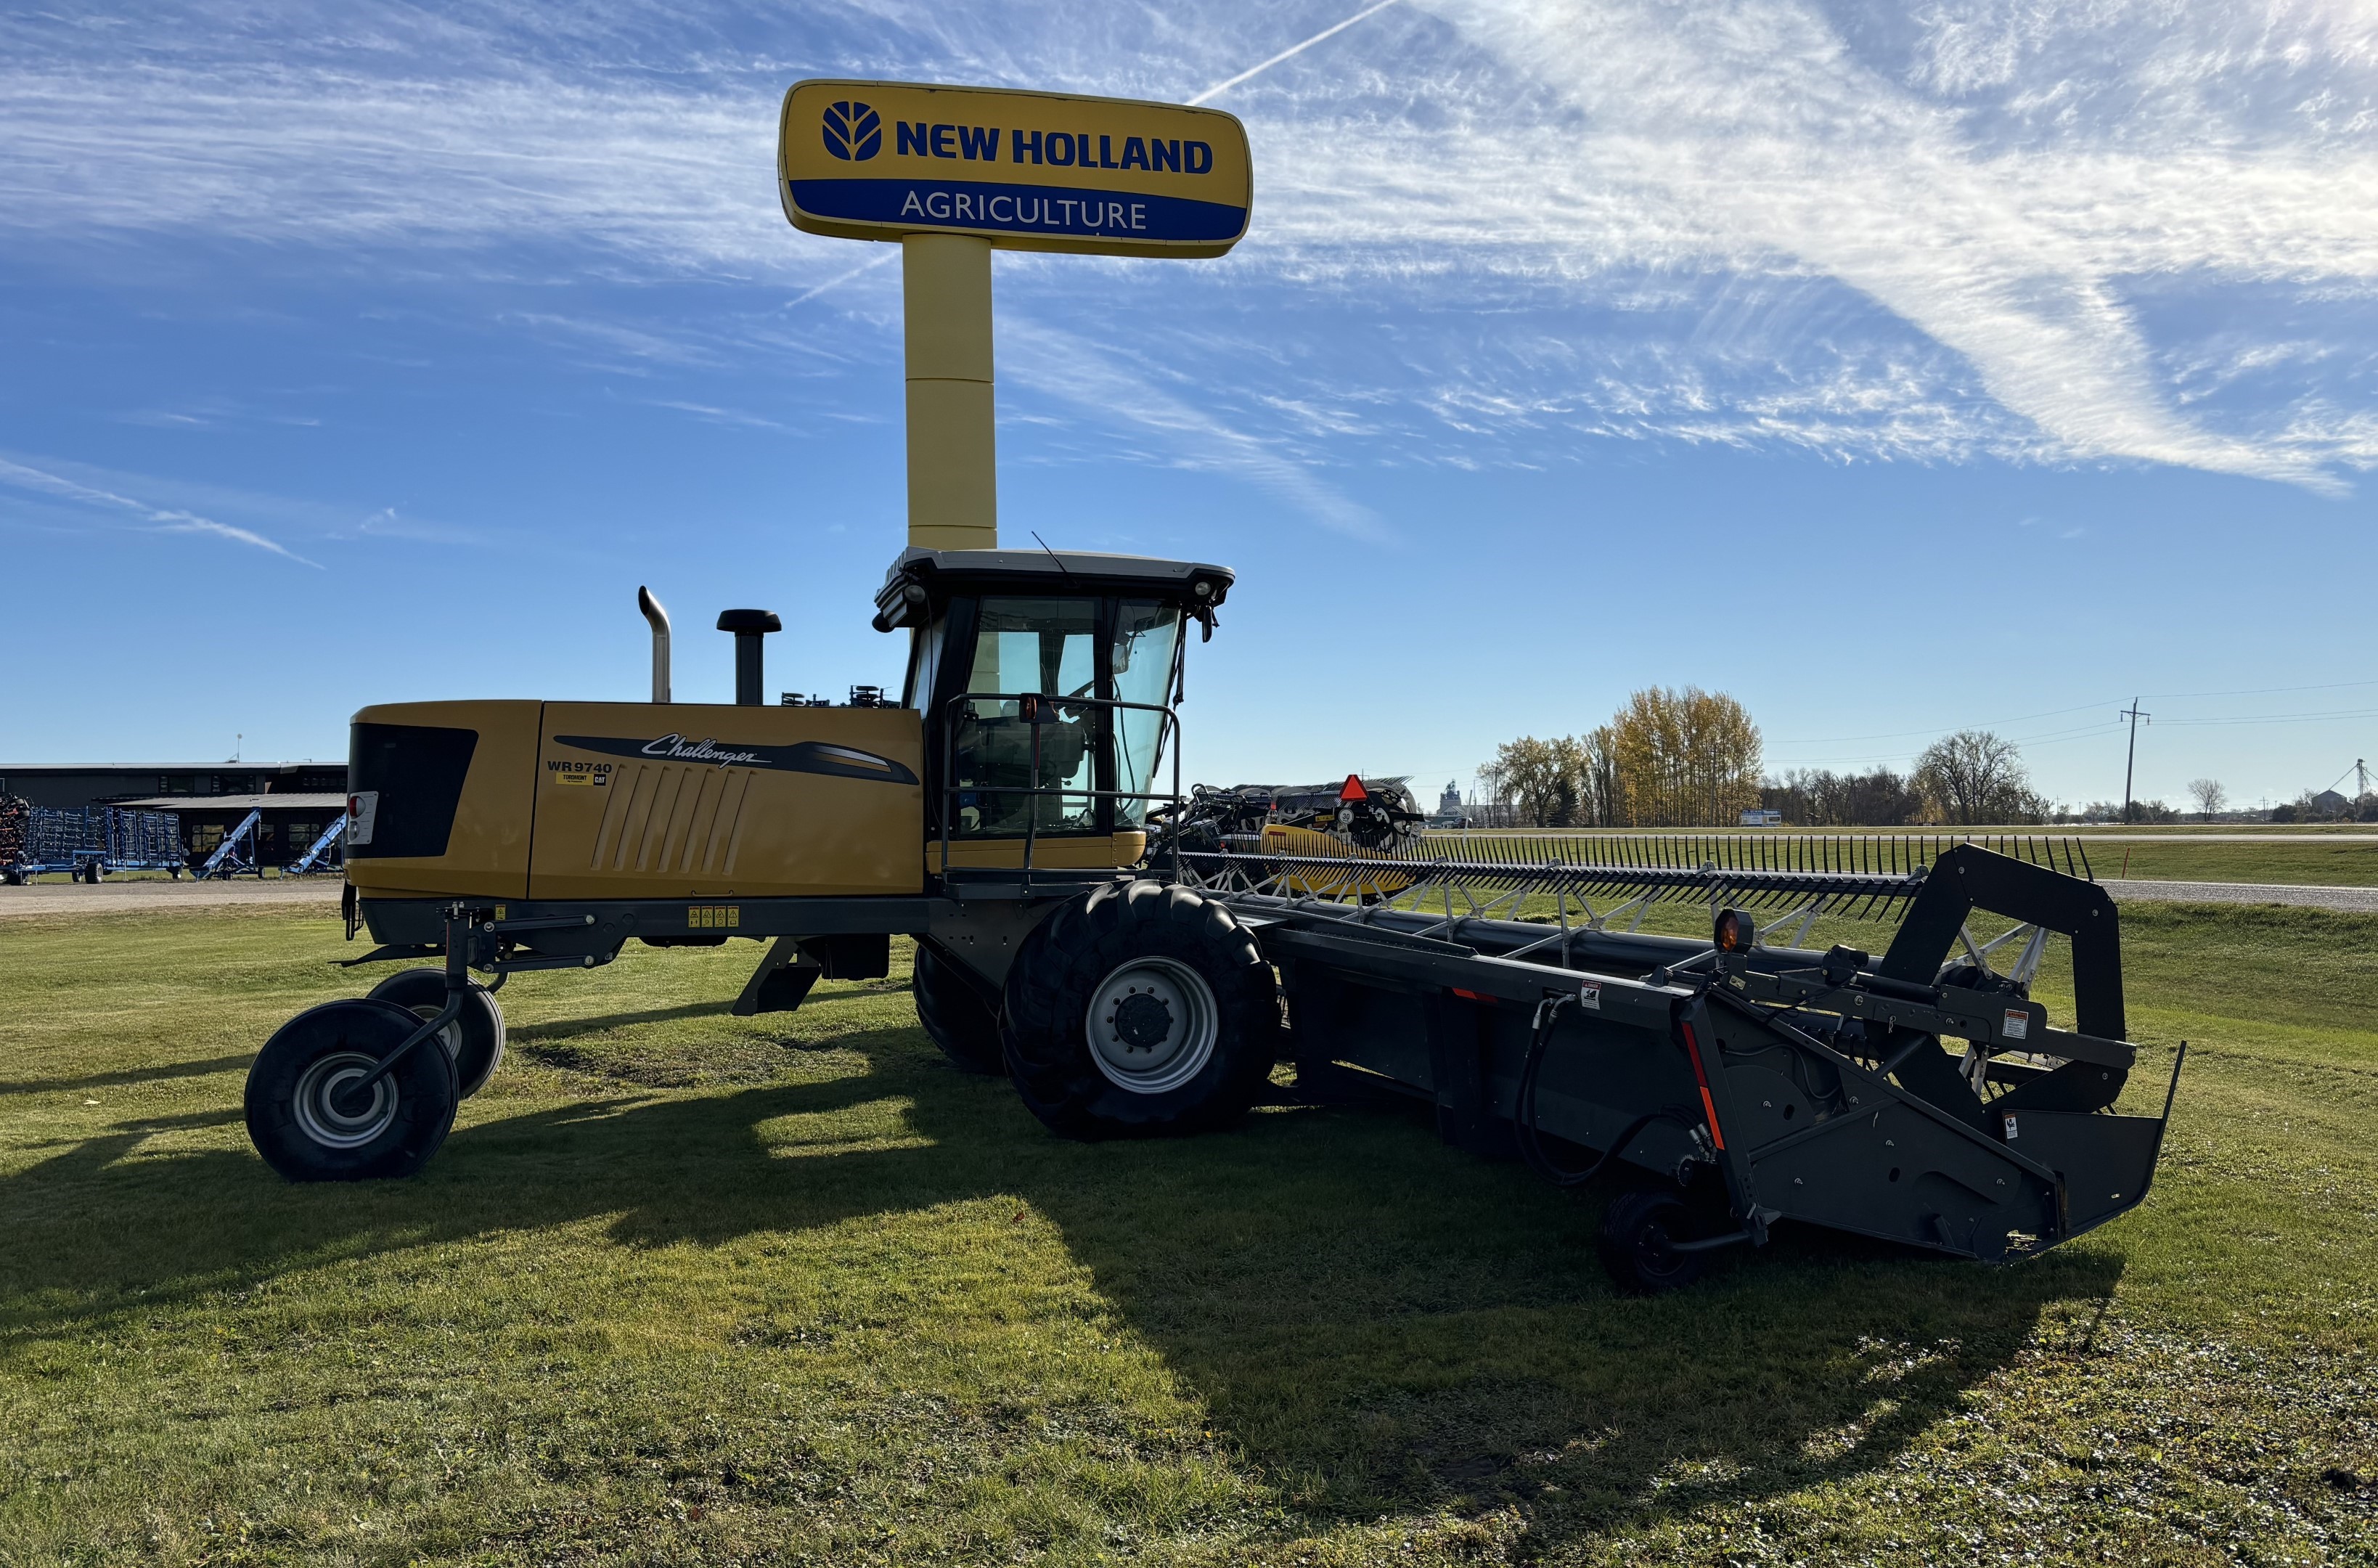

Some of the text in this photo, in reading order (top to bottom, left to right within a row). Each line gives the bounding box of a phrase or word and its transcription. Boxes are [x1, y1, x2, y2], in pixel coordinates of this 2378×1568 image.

[896, 121, 1213, 174] NEW HOLLAND
[900, 190, 1146, 230] AGRICULTURE
[547, 761, 612, 773] WR 9740
[641, 733, 772, 769] Challenger
